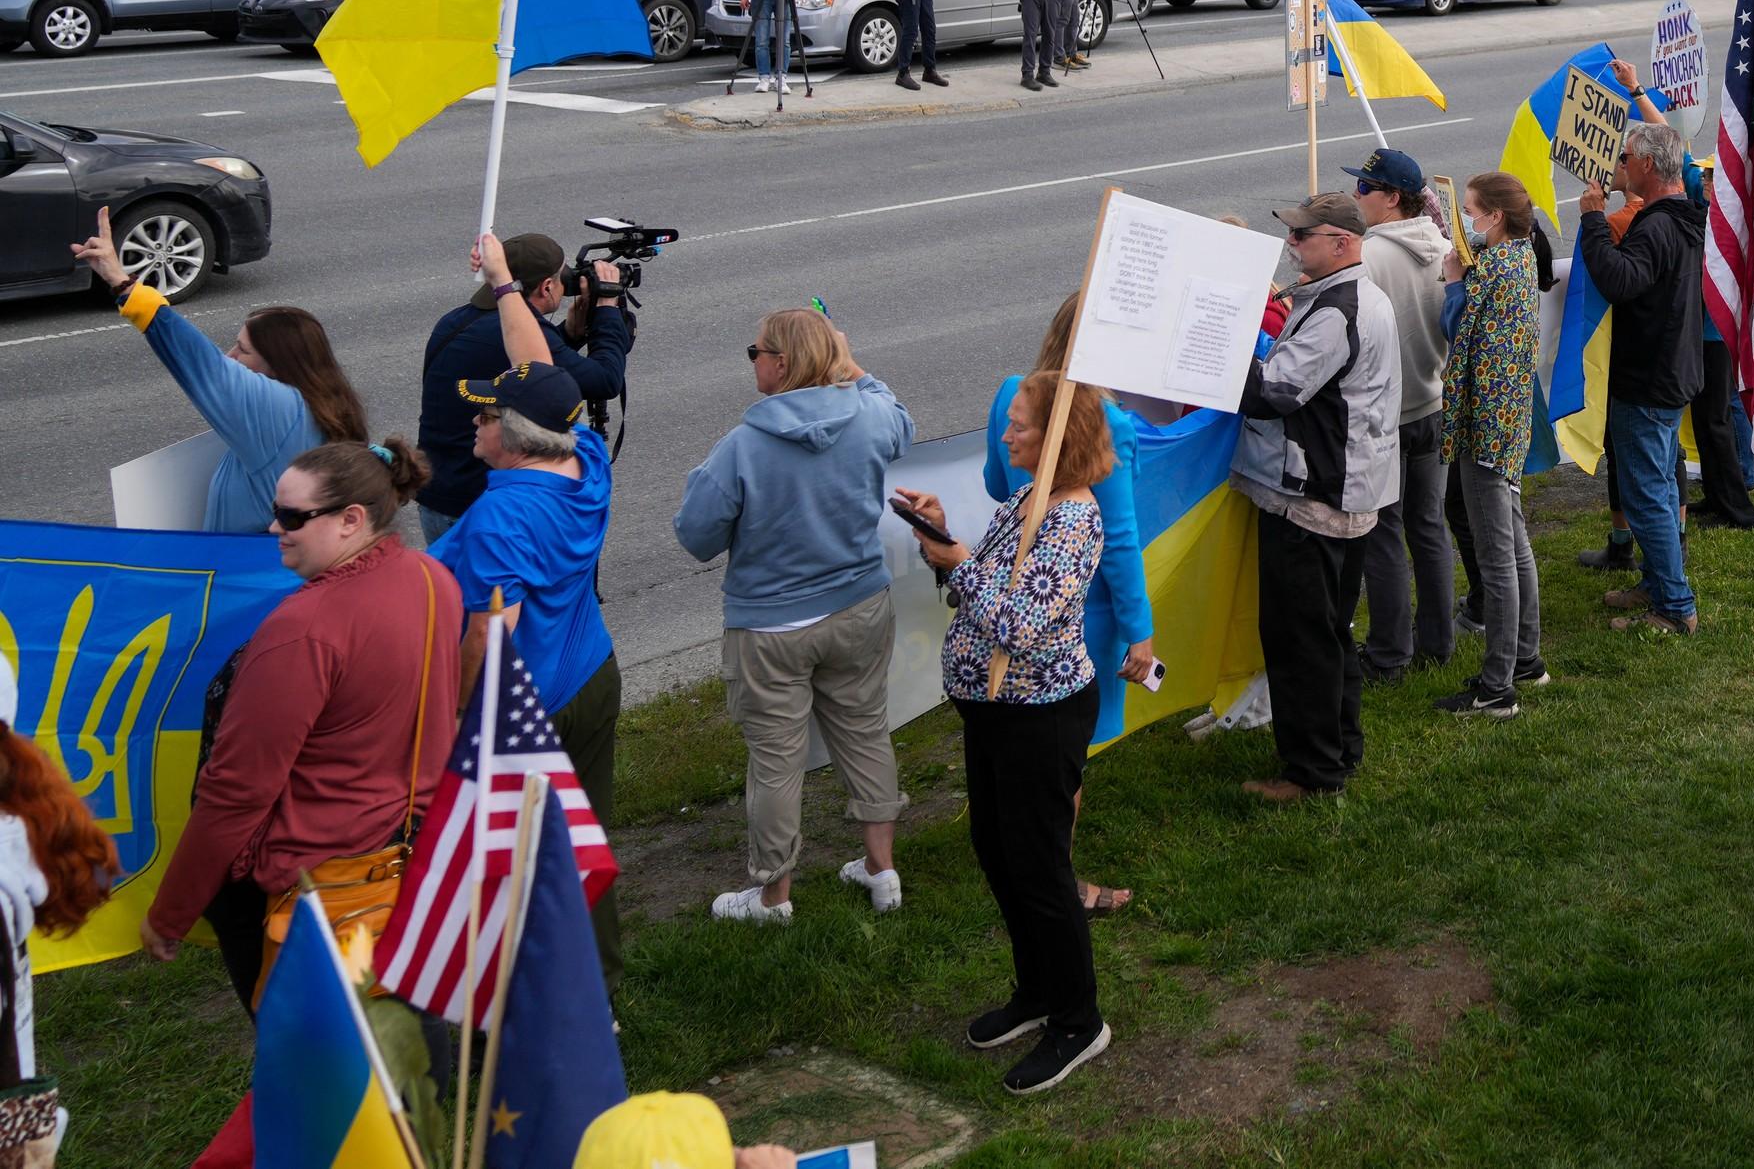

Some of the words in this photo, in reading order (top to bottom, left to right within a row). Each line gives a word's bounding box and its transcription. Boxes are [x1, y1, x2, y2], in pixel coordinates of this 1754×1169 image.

[1657, 10, 1692, 45] HONK
[1663, 45, 1674, 59] you
[1674, 38, 1688, 52] want
[1652, 46, 1704, 90] DEMOCRACY
[1567, 74, 1579, 101] I
[1581, 84, 1626, 133] STAND
[1664, 80, 1700, 112] BACK!
[1574, 113, 1616, 162] WITH
[1552, 136, 1613, 191] UKRAINE
